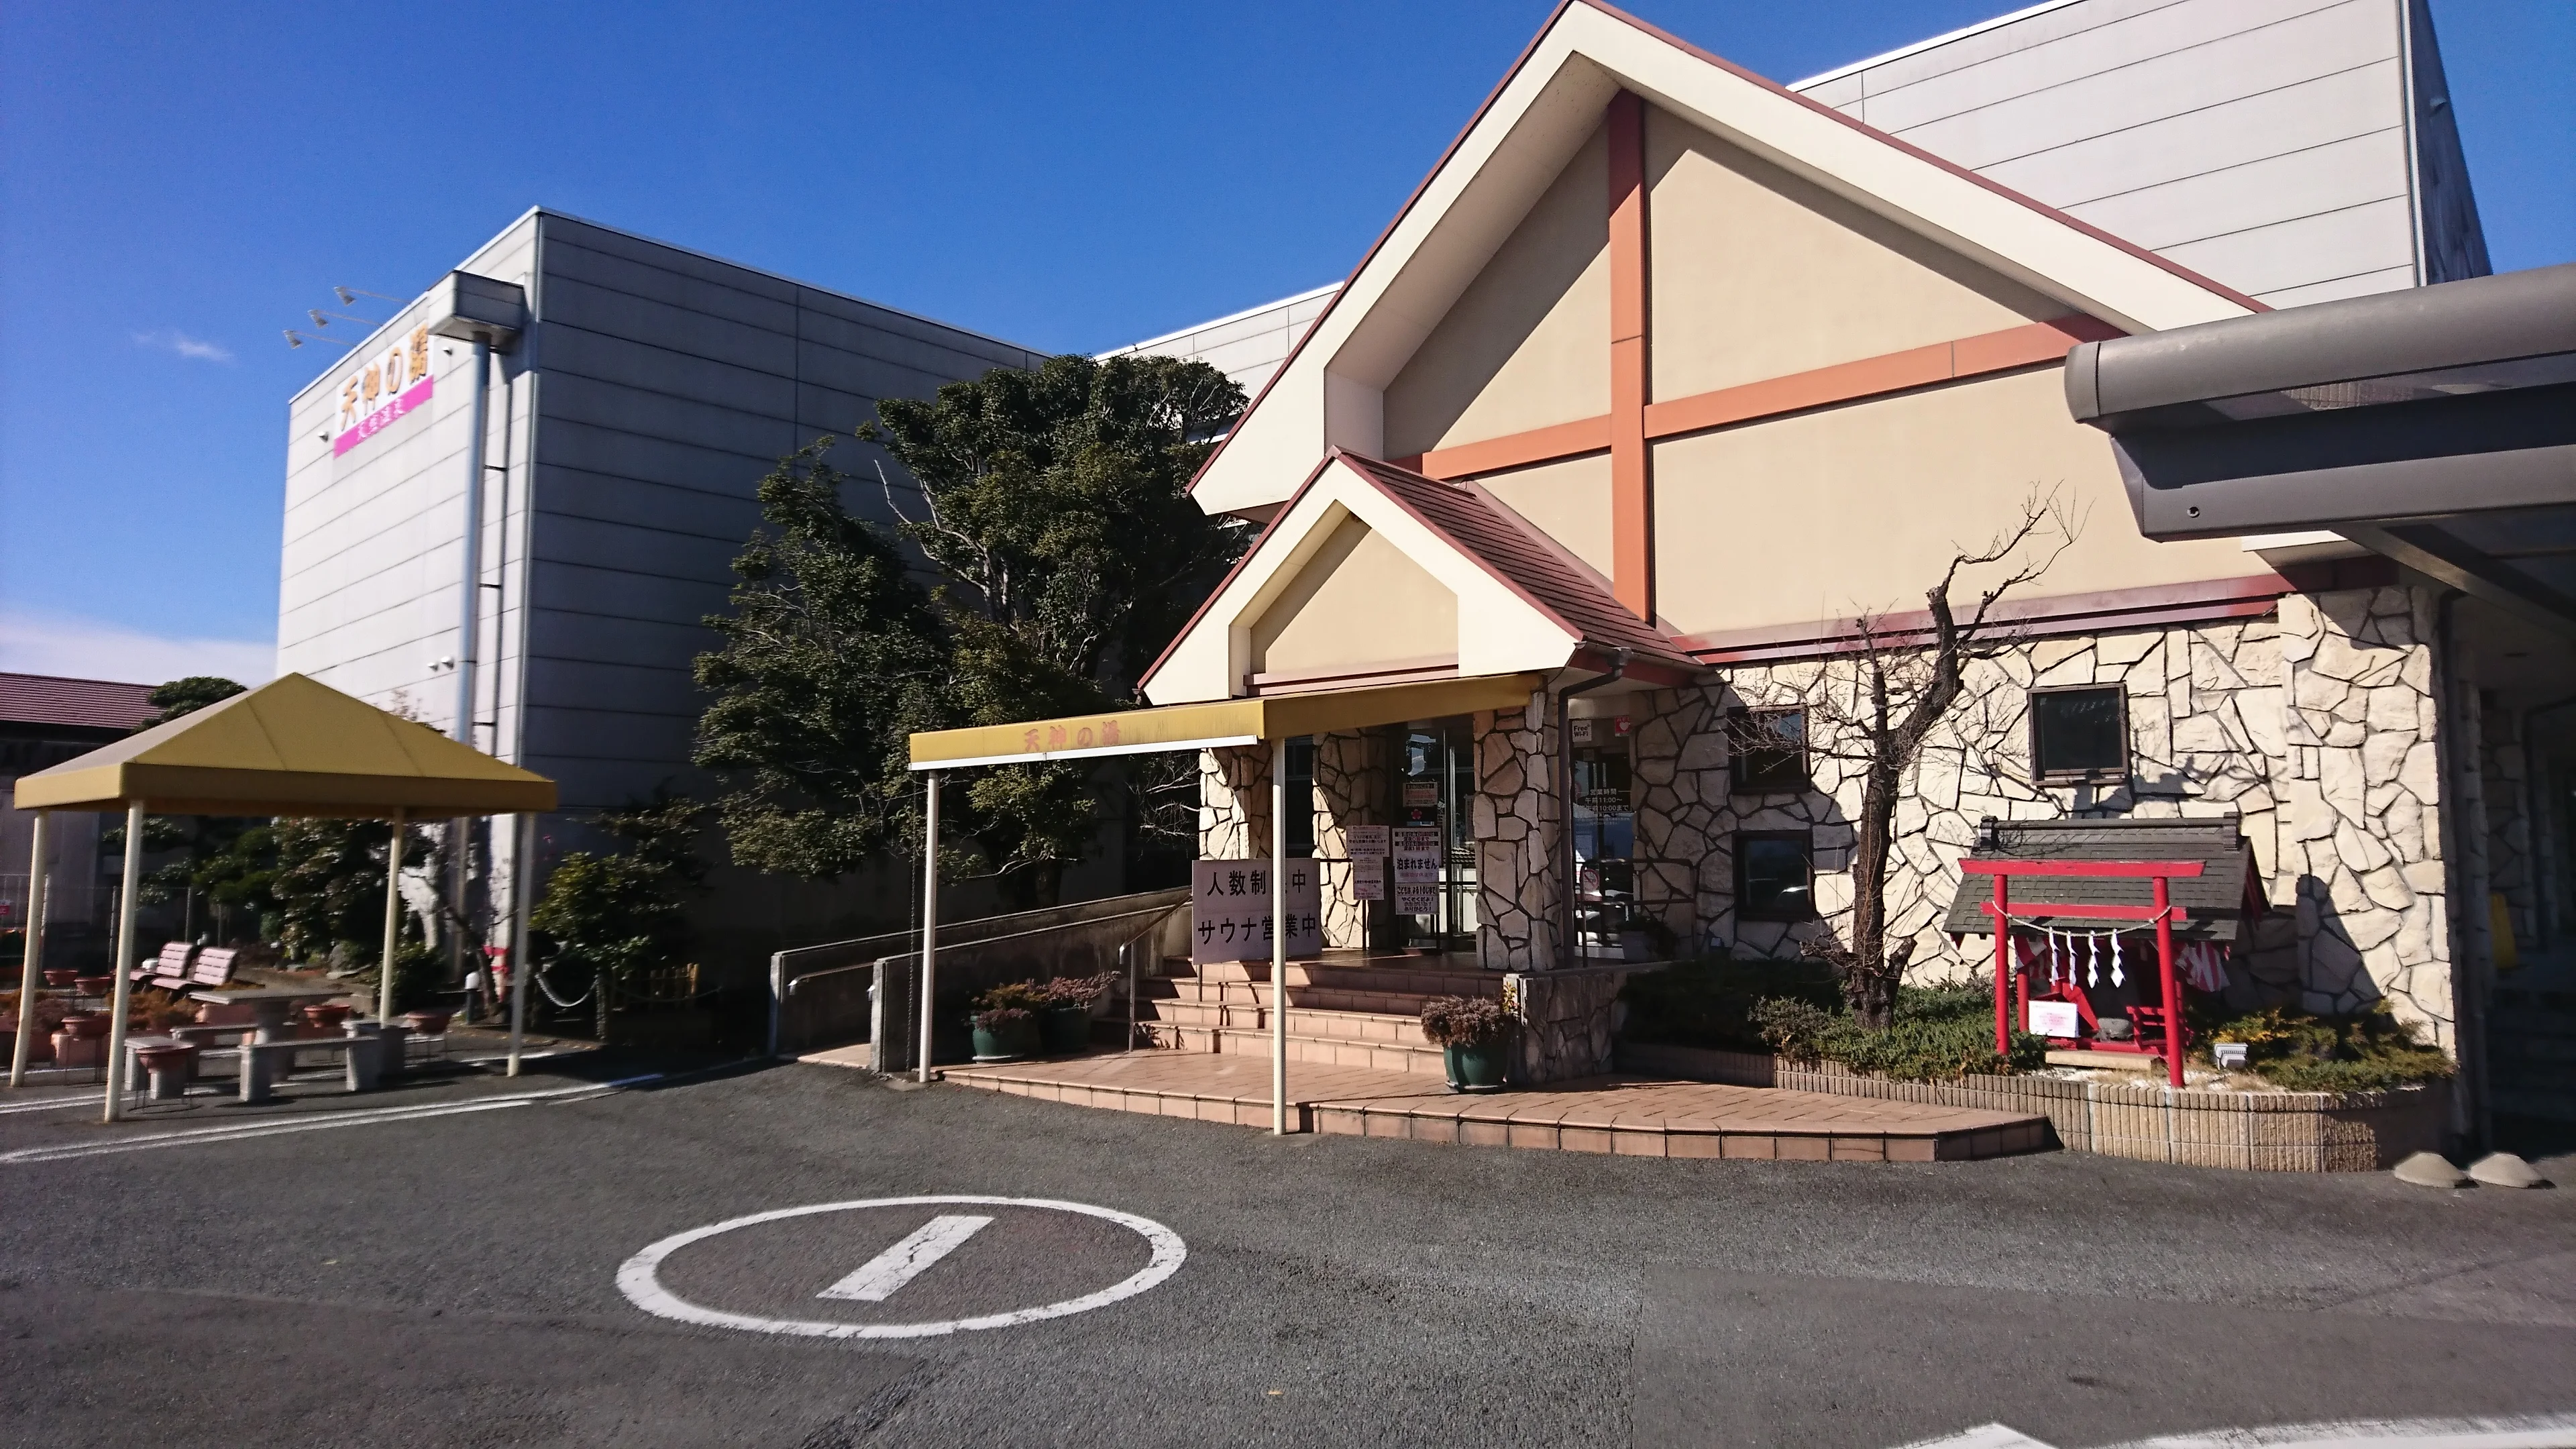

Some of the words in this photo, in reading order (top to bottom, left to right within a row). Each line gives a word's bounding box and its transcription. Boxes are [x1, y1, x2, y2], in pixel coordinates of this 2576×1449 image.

[1024, 720, 1122, 753] 天神の湯
[1397, 858, 1438, 870] 泊まれません
[1208, 869, 1306, 897] 人数制中
[1198, 912, 1316, 946] サウナ営業中
